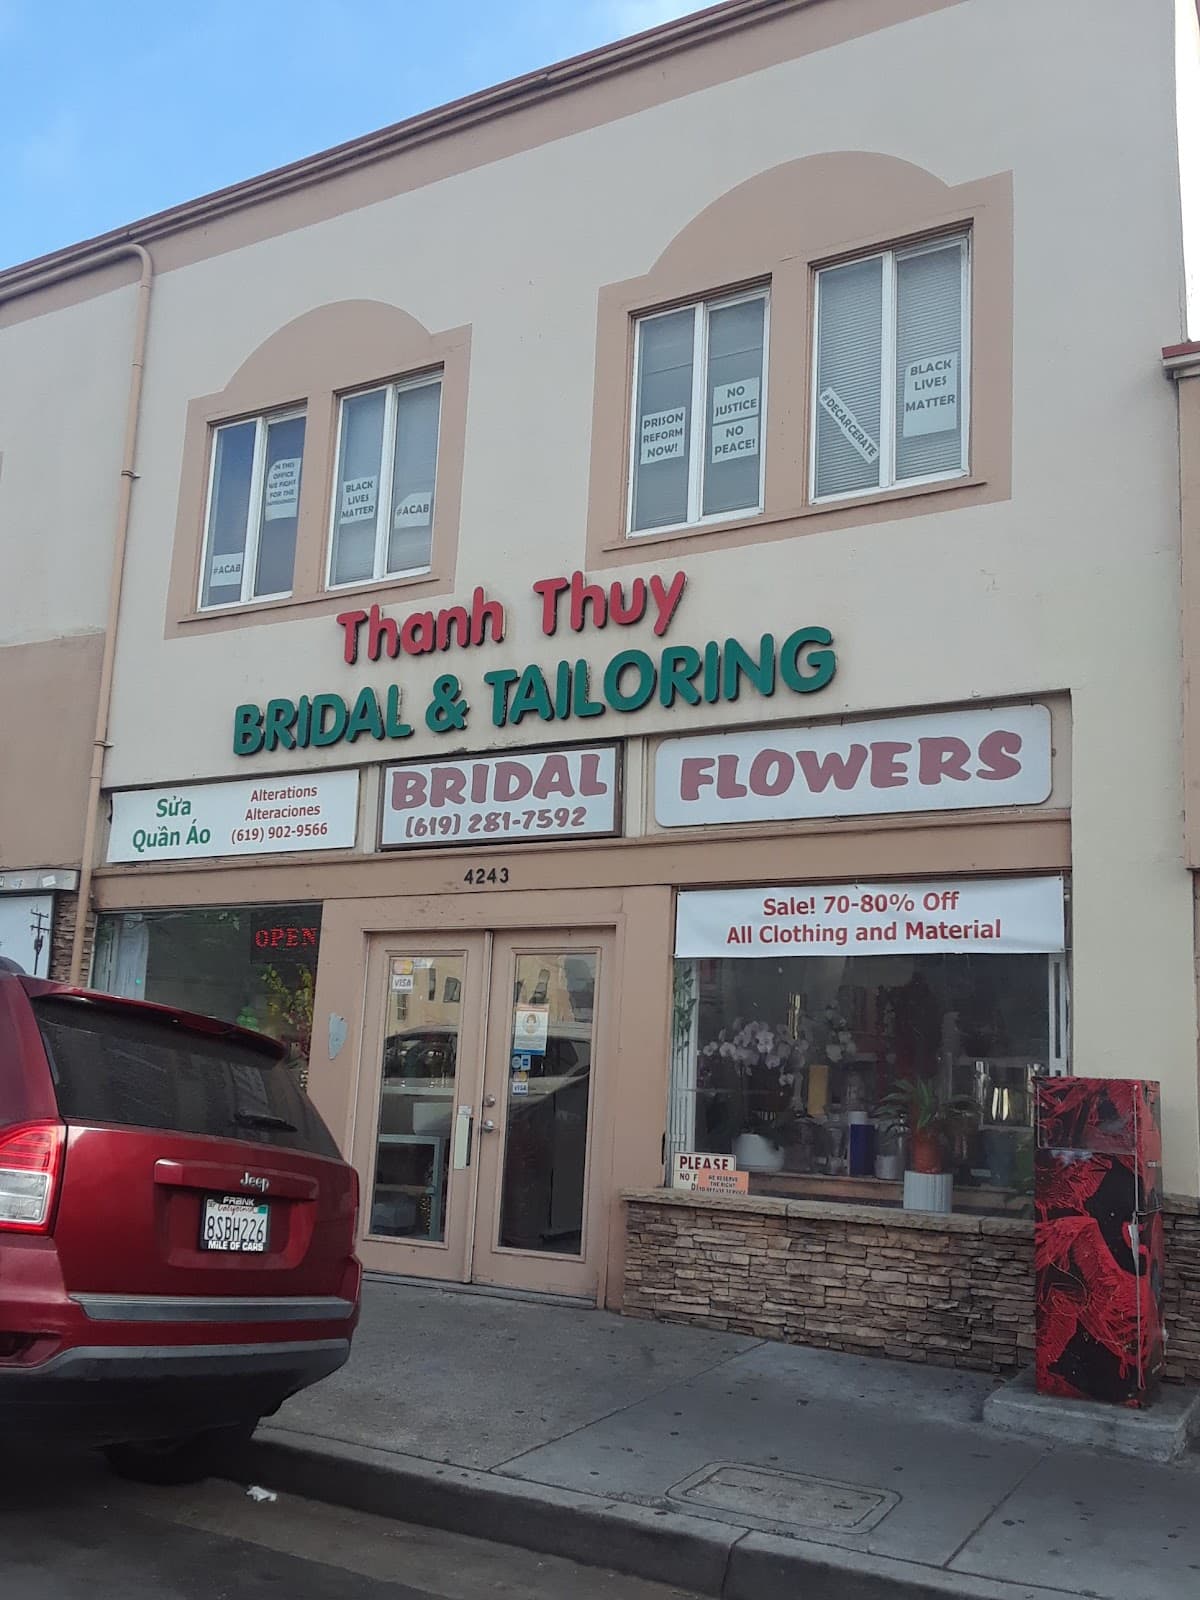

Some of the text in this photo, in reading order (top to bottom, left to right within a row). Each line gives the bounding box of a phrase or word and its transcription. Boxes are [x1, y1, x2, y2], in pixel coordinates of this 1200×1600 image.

[910, 359, 952, 376] BLACK
[727, 385, 745, 398] NO
[914, 375, 947, 391] LIVES
[715, 398, 757, 417] JUSTICE
[905, 394, 956, 412] MATTER
[643, 412, 684, 429] PRISON
[822, 394, 877, 456] #DECARCERATE
[643, 427, 683, 443] REFORM
[725, 425, 744, 438] NO
[647, 443, 678, 458] NOW!
[714, 438, 756, 455] PEACE!
[345, 480, 374, 493] BLACK
[347, 494, 369, 505] LIVES
[341, 505, 374, 519] MATTER
[336, 570, 688, 665] Thanh Thuy
[232, 626, 837, 757] BRIDAL & TAILORING
[680, 730, 1023, 801] FLOWERS
[391, 754, 608, 811] BRIDAL
[251, 785, 318, 802] Alterations
[245, 804, 321, 822] Alteraciones
[405, 806, 587, 838] (619) 281-7592
[231, 822, 328, 845] (619) 902-9566
[464, 867, 509, 884] 4243
[763, 890, 960, 916] Sale! 70-80% Off
[255, 927, 318, 948] OPEN
[727, 918, 1001, 946] All Clothing and Material
[394, 978, 412, 987] VISA
[680, 1156, 729, 1170] PLEASE
[240, 1172, 269, 1192] Jeep
[679, 1172, 690, 1181] NO
[206, 1215, 265, 1243] 8SBH226
[229, 1241, 240, 1250] OF
[242, 1242, 264, 1252] CARS
